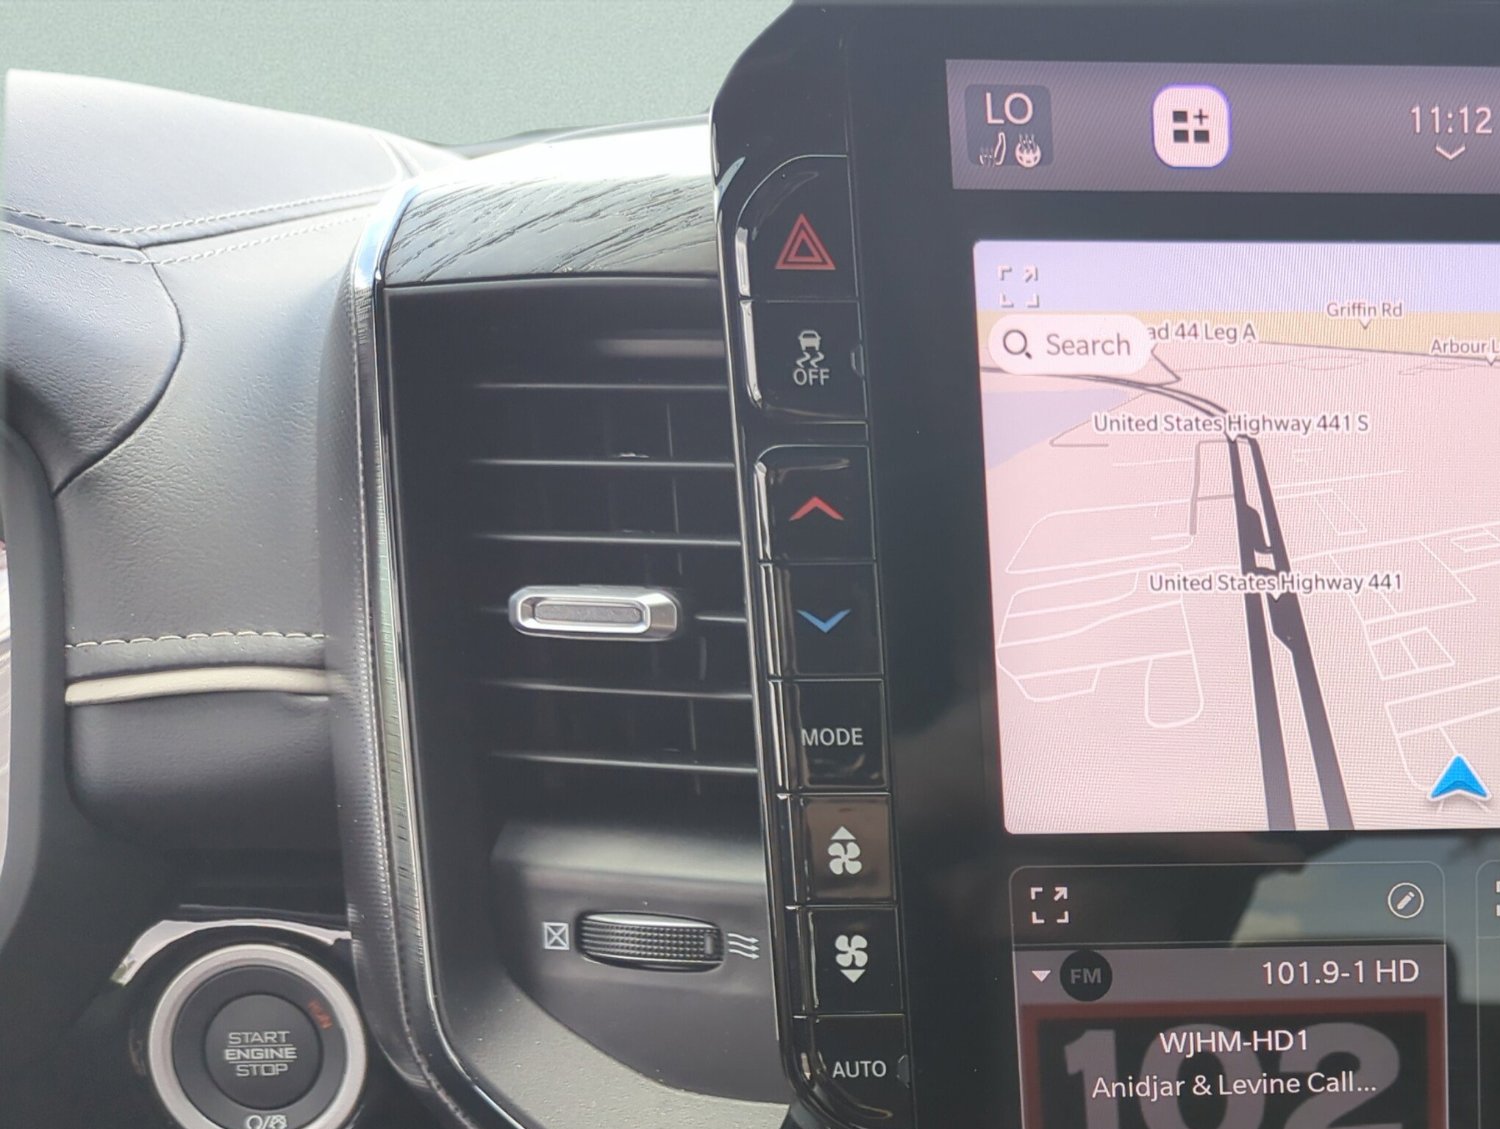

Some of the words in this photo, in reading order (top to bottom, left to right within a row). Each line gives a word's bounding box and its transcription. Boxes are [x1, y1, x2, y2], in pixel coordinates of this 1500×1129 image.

[984, 92, 1034, 125] LO
[1410, 105, 1493, 135] 11:12
[1326, 302, 1377, 318] Griffin
[1383, 302, 1403, 318] Rd
[1174, 324, 1199, 341] 44
[1204, 324, 1238, 344] Leg
[1242, 324, 1256, 341] A
[1046, 333, 1131, 356] Search
[1430, 338, 1488, 355] Arbour
[792, 368, 830, 387] OFF
[1094, 414, 1158, 433] United
[1163, 414, 1223, 433] States
[1228, 414, 1312, 436] Highway
[1316, 414, 1352, 432] 441
[1356, 414, 1369, 432] S
[1149, 574, 1212, 592] United
[1217, 574, 1276, 592] States
[1281, 574, 1364, 595] Highway
[1368, 574, 1402, 590] 441
[800, 728, 864, 747] MODE
[1070, 968, 1102, 985] FM
[1262, 961, 1365, 986] 101.9-1
[1376, 959, 1419, 984] HD
[228, 1030, 290, 1045] START
[1159, 1030, 1309, 1058] WJHM-HD1
[224, 1047, 297, 1061] ENGINE
[235, 1063, 289, 1077] STOP
[832, 1060, 887, 1079] AUTO
[1092, 1074, 1186, 1102] Anidjar
[1192, 1075, 1211, 1097] &
[1218, 1072, 1300, 1096] Levine
[1307, 1071, 1377, 1094] Call...
